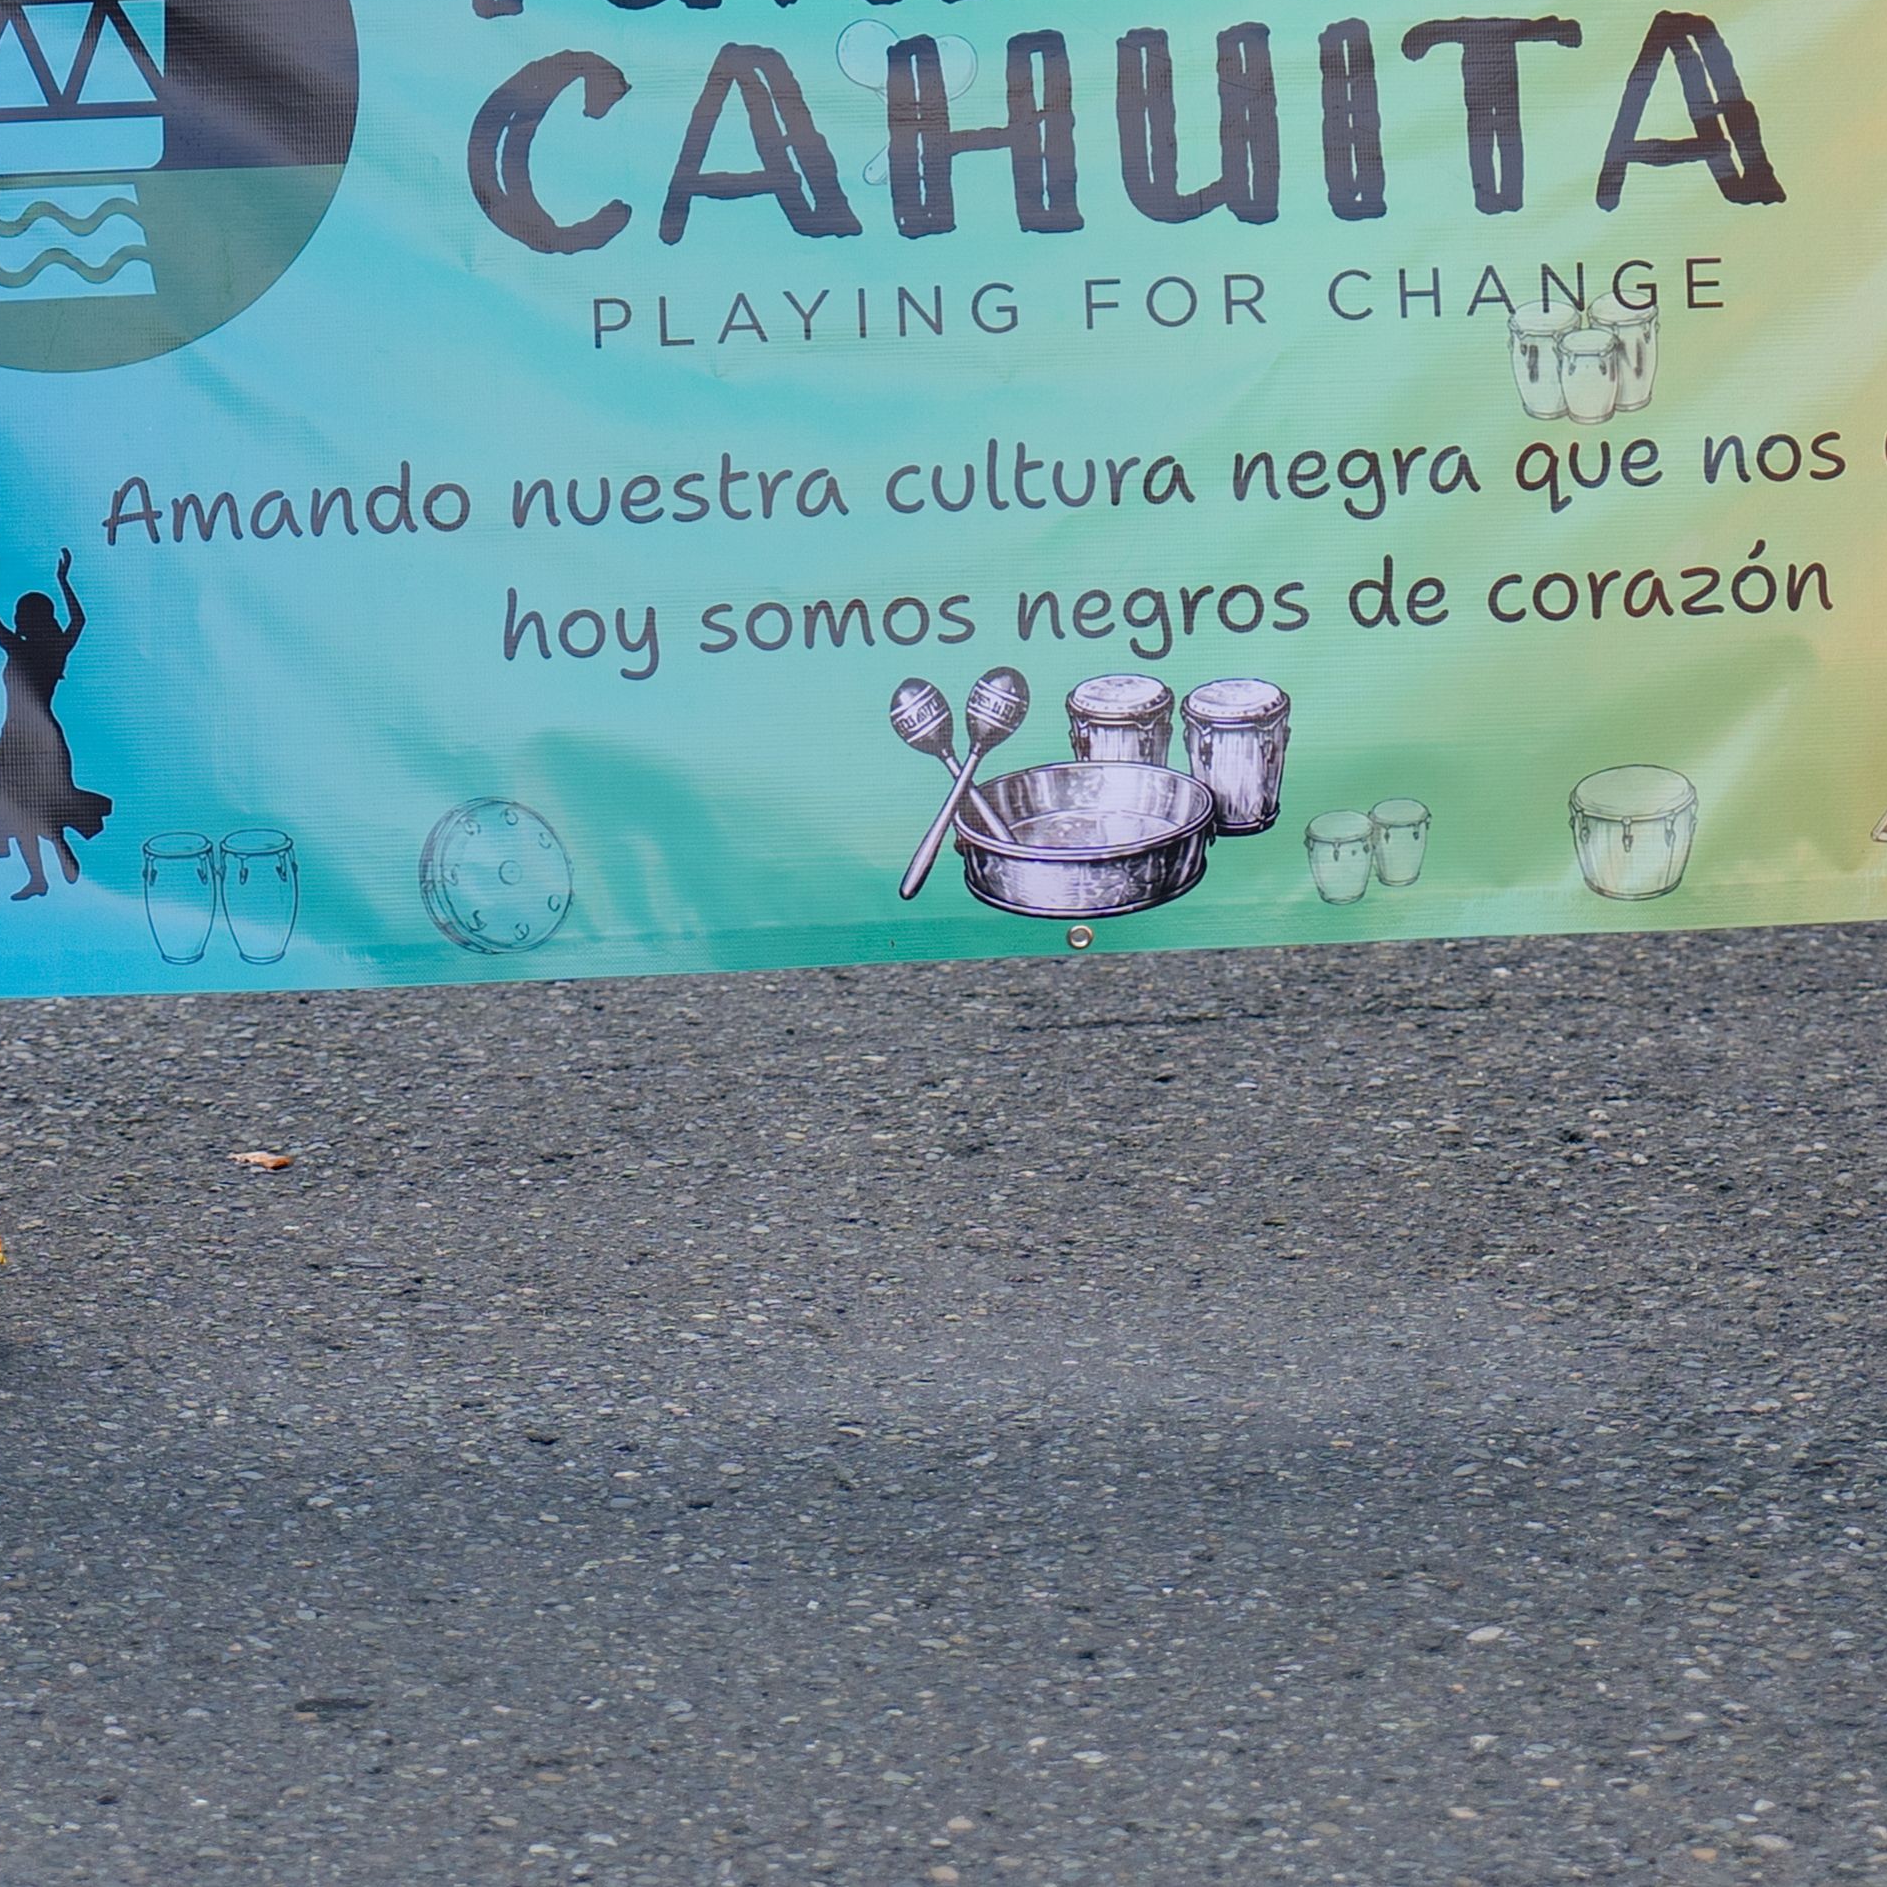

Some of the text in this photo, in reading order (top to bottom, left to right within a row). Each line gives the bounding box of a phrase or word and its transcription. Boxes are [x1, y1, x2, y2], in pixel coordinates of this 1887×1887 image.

[467, 10, 1787, 255] CAHUITA
[593, 256, 1726, 350] PLAYING FOR CHANGE
[103, 459, 472, 547] Amando
[512, 451, 850, 530] nuestra
[885, 437, 1196, 515] cultura
[1233, 448, 1482, 521] negra
[1515, 435, 1666, 513] que
[1703, 429, 1849, 486] nos
[503, 539, 1835, 681] hoy somos negros de corazón
